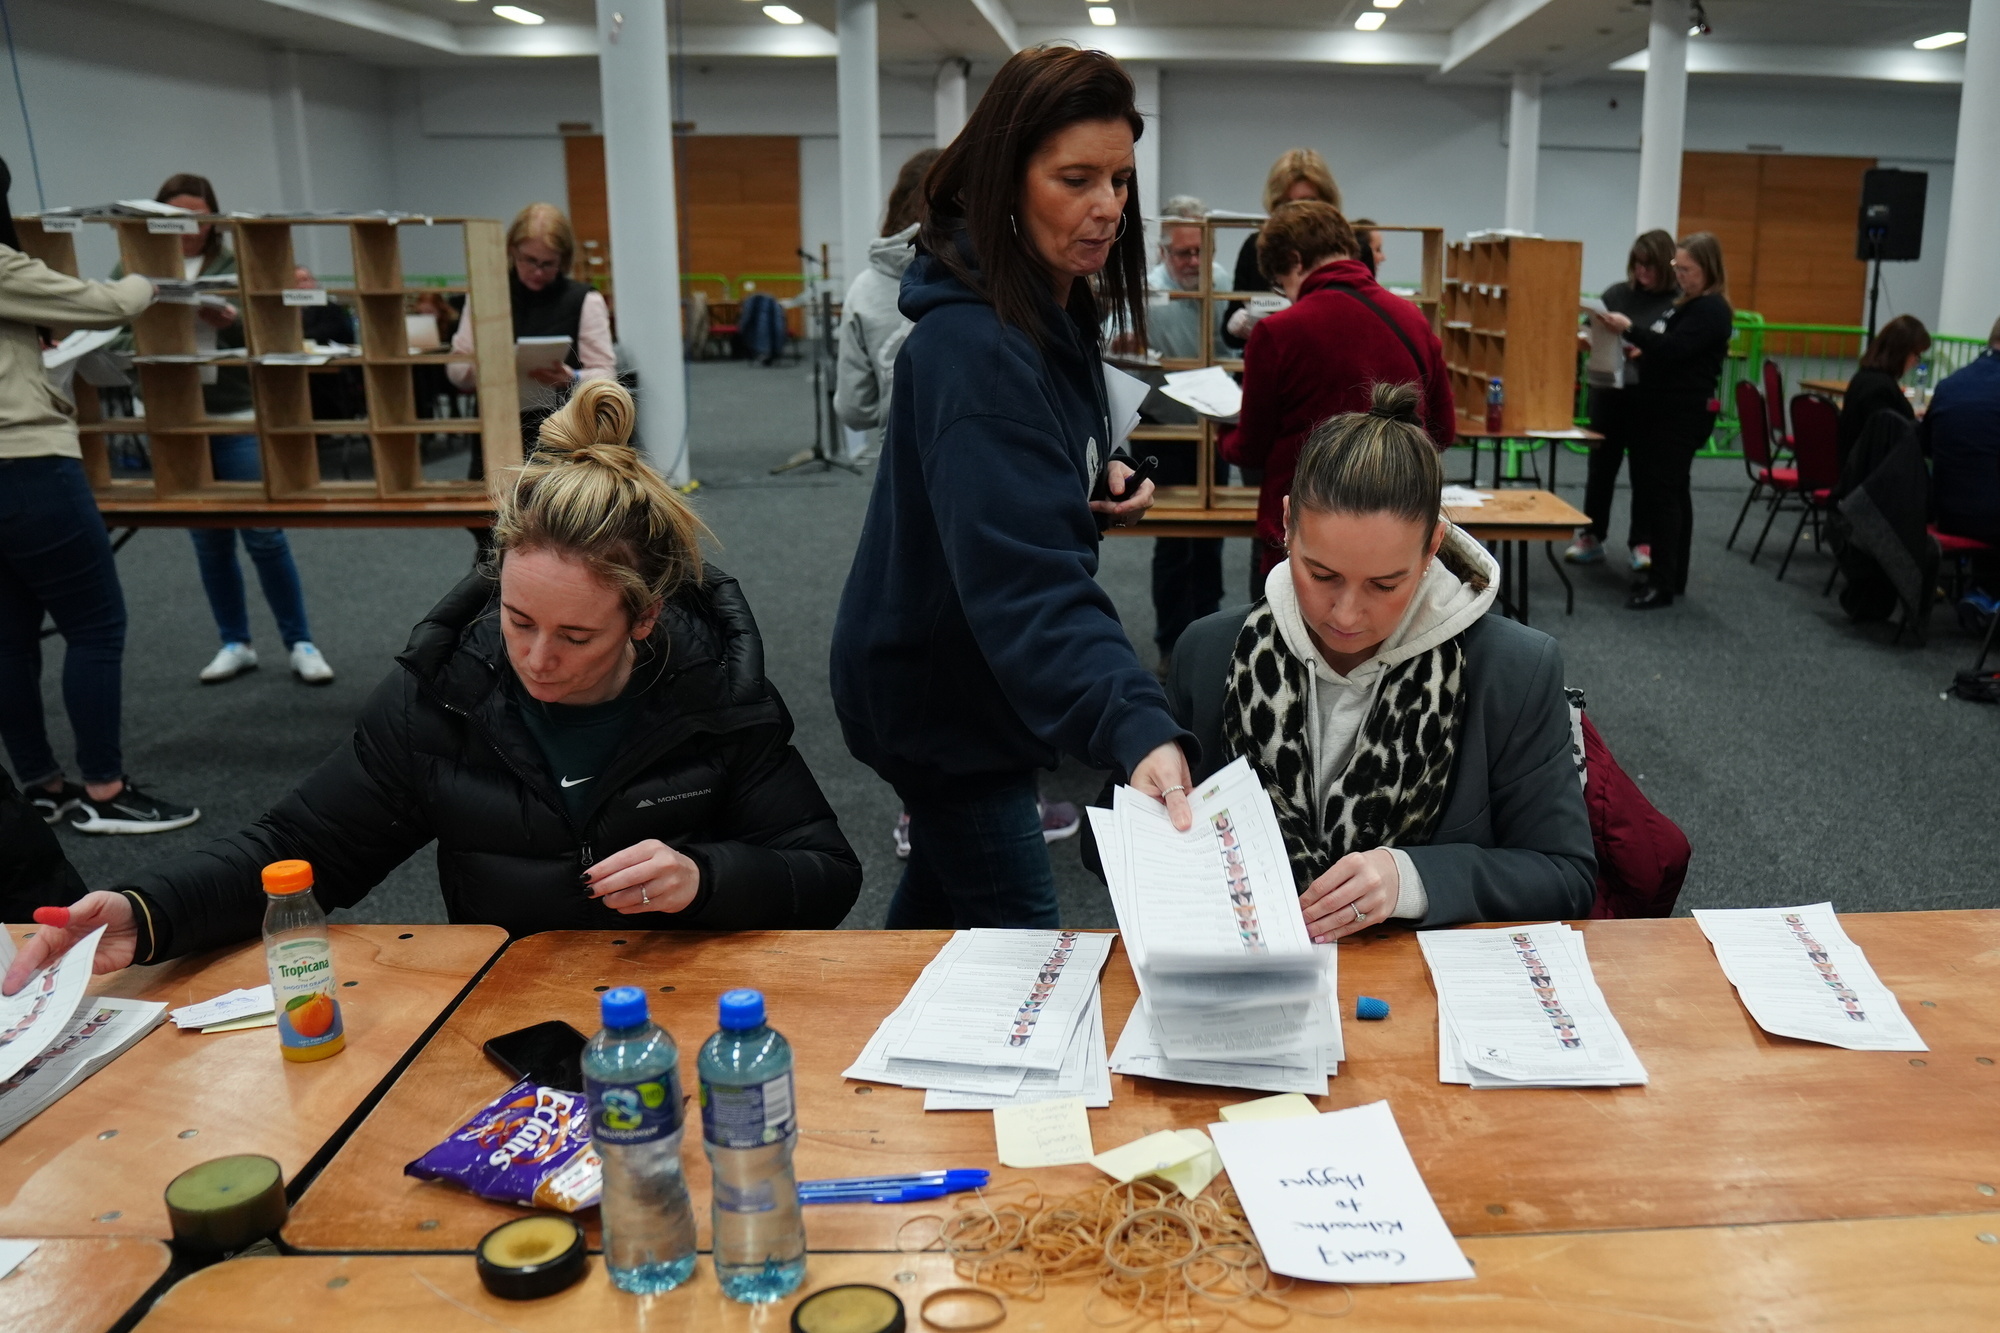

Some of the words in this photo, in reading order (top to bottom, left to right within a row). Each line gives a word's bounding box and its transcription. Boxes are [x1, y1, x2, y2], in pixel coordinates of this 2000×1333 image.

[1252, 299, 1281, 308] Mullen
[658, 788, 711, 803] MONTERRAIN
[278, 958, 330, 979] Tropicana
[283, 983, 308, 991] SMOOTH
[1481, 1055, 1509, 1064] COUNT
[1485, 1047, 1500, 1058] 2
[489, 1086, 575, 1171] Eclairs
[1278, 1166, 1365, 1191] Higgins
[1334, 1197, 1363, 1213] to
[1293, 1219, 1403, 1236] Kilmartin
[1316, 1243, 1339, 1268] 7
[1342, 1249, 1406, 1267] Count
